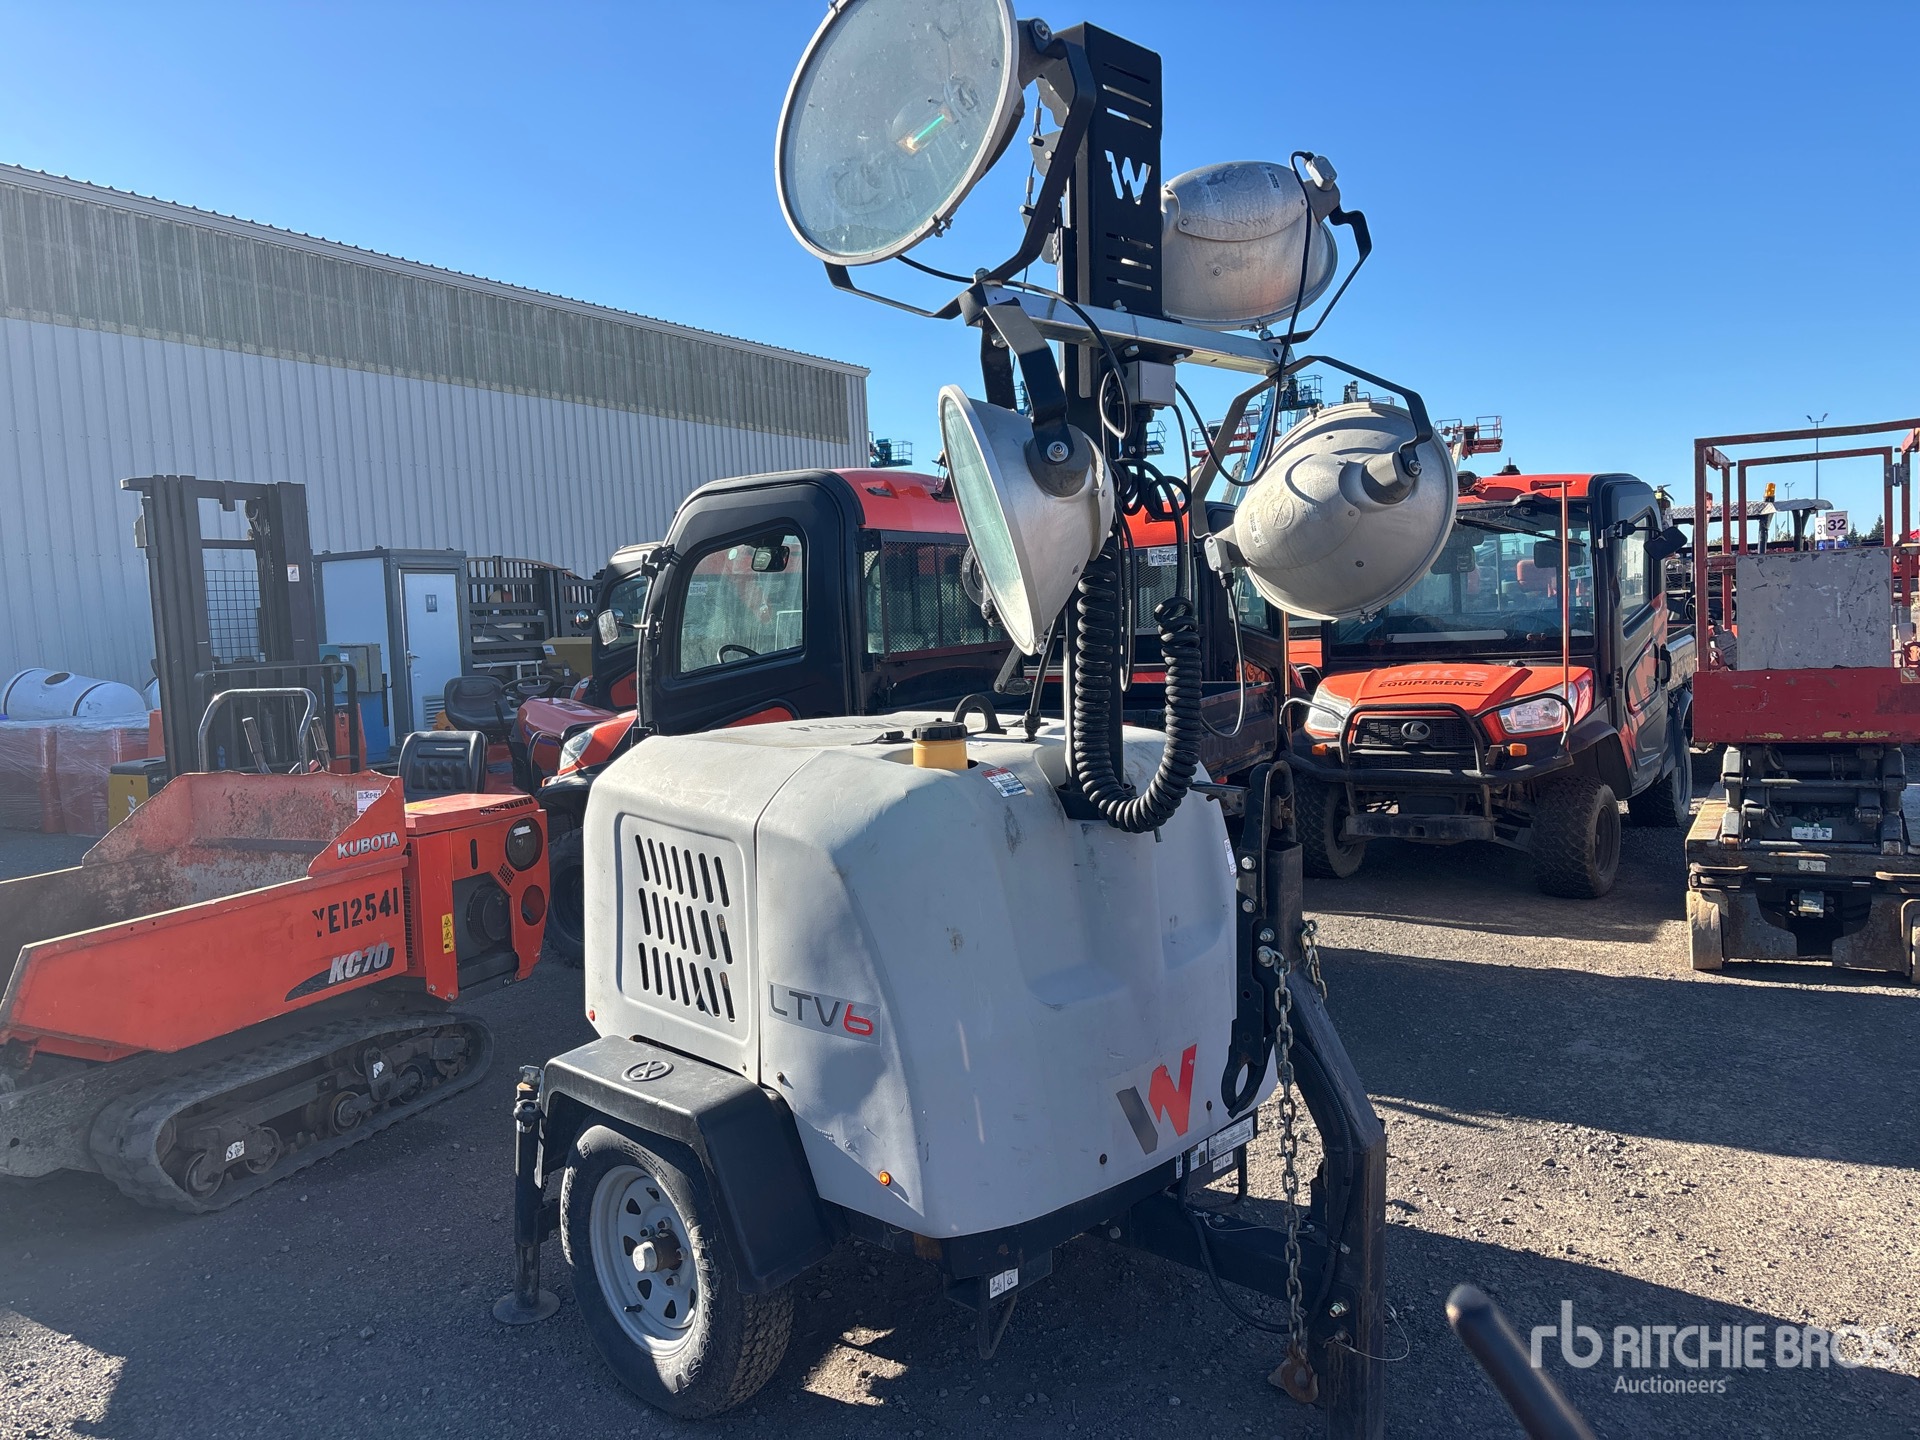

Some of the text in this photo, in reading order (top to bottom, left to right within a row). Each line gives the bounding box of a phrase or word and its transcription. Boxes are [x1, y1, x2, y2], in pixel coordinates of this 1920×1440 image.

[1828, 518, 1846, 531] 32
[1378, 680, 1485, 688] EQUIPEMENTS
[1384, 669, 1489, 681] MKS
[337, 831, 399, 859] KUBOTA
[328, 942, 390, 984] KC70
[770, 984, 874, 1037] LTV6
